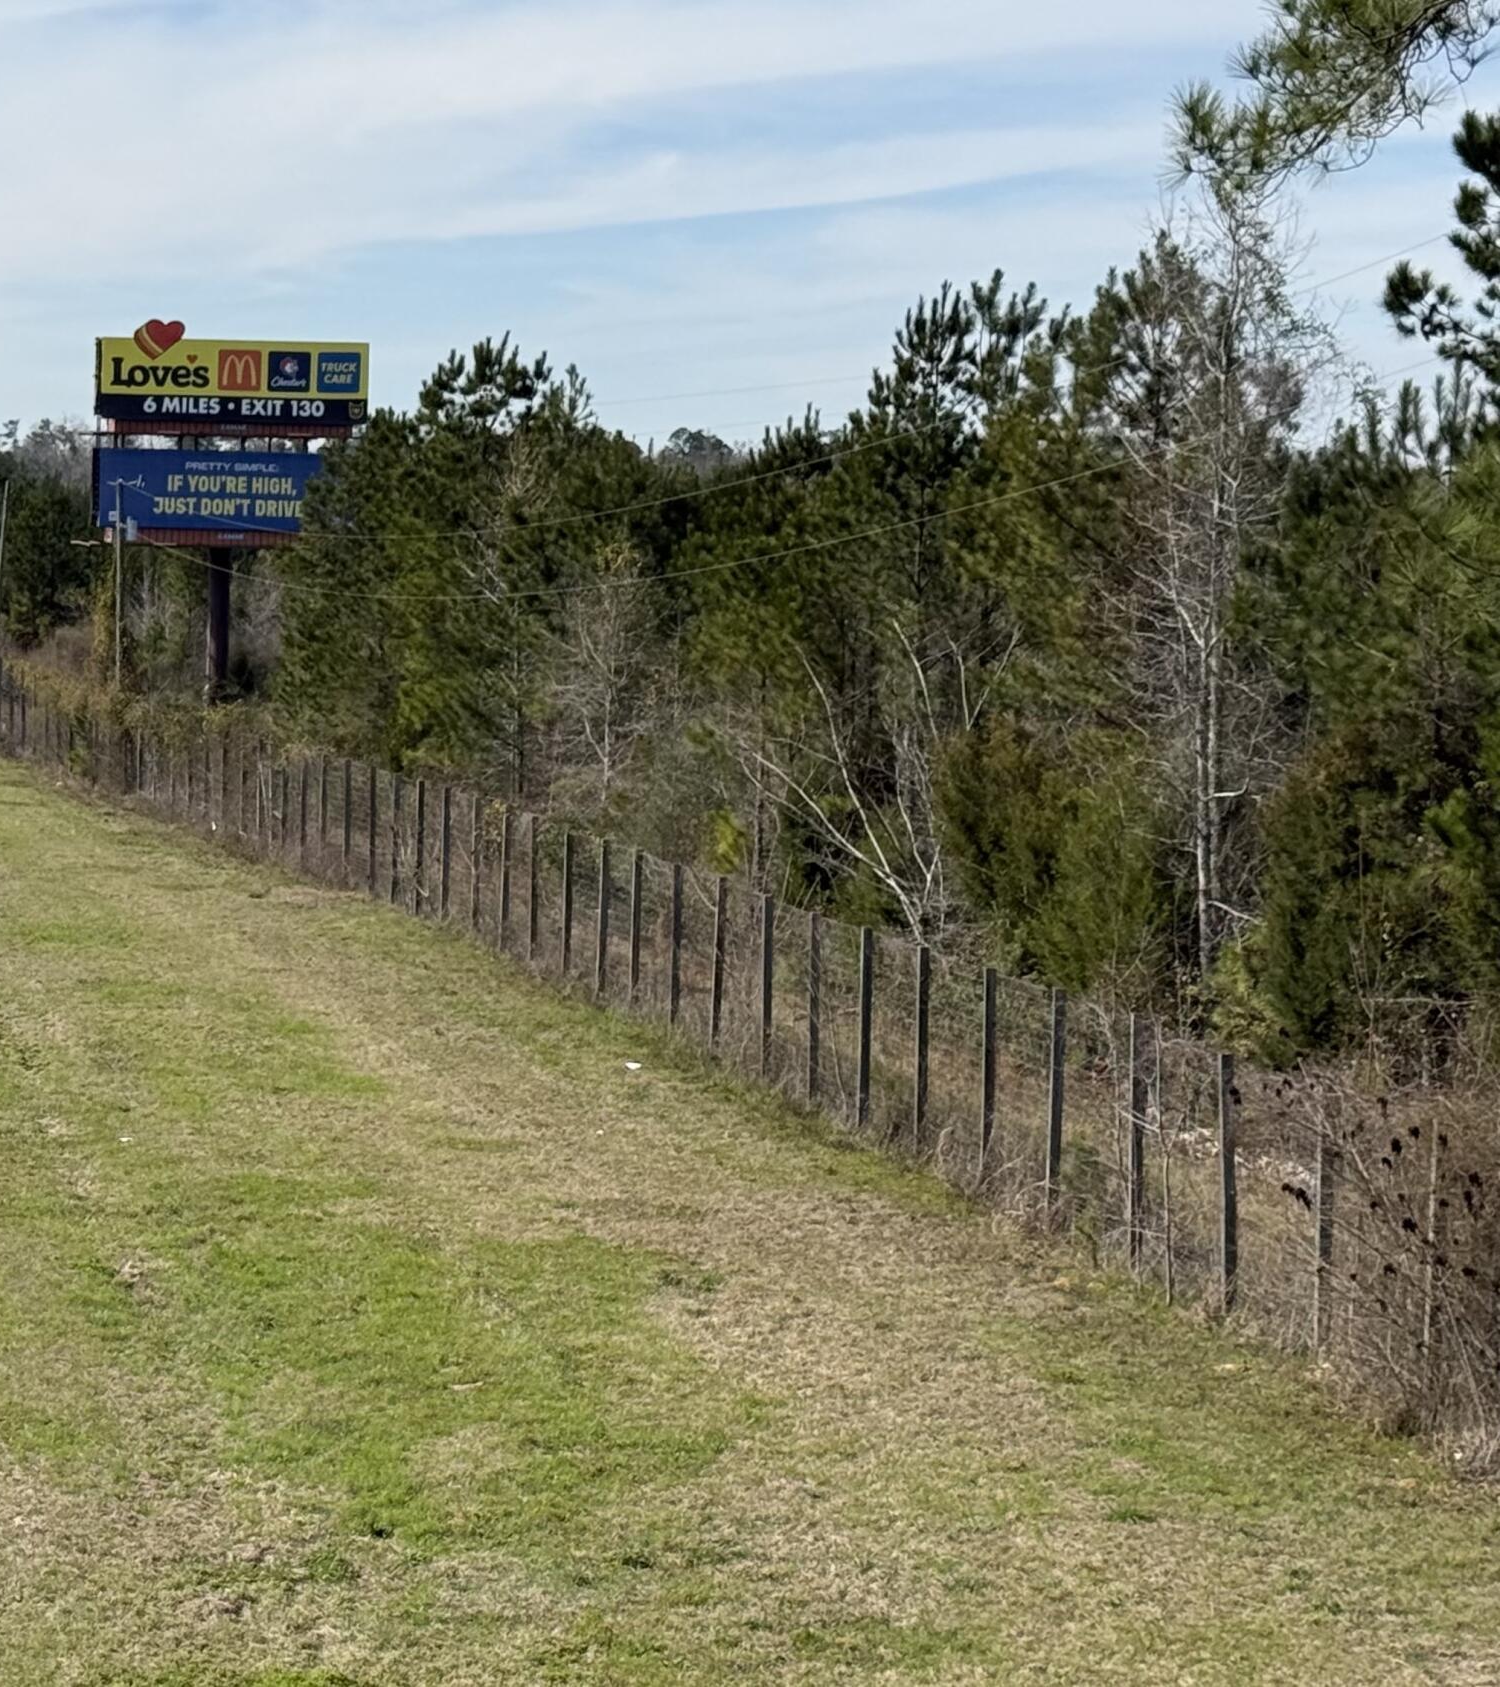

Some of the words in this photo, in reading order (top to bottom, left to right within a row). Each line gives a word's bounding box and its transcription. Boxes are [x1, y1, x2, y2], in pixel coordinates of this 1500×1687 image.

[321, 362, 357, 373] TRUCK
[324, 374, 353, 384] CARE
[143, 397, 157, 413] 6
[161, 397, 221, 414] MILES
[241, 399, 284, 416] EXIT
[290, 400, 325, 417] 130
[185, 461, 231, 471] PRETTY
[167, 475, 184, 492] IF
[188, 475, 248, 493] YOU'RE
[252, 477, 297, 496] HIGH,
[153, 497, 197, 515] JUST
[201, 498, 251, 516] DON'T
